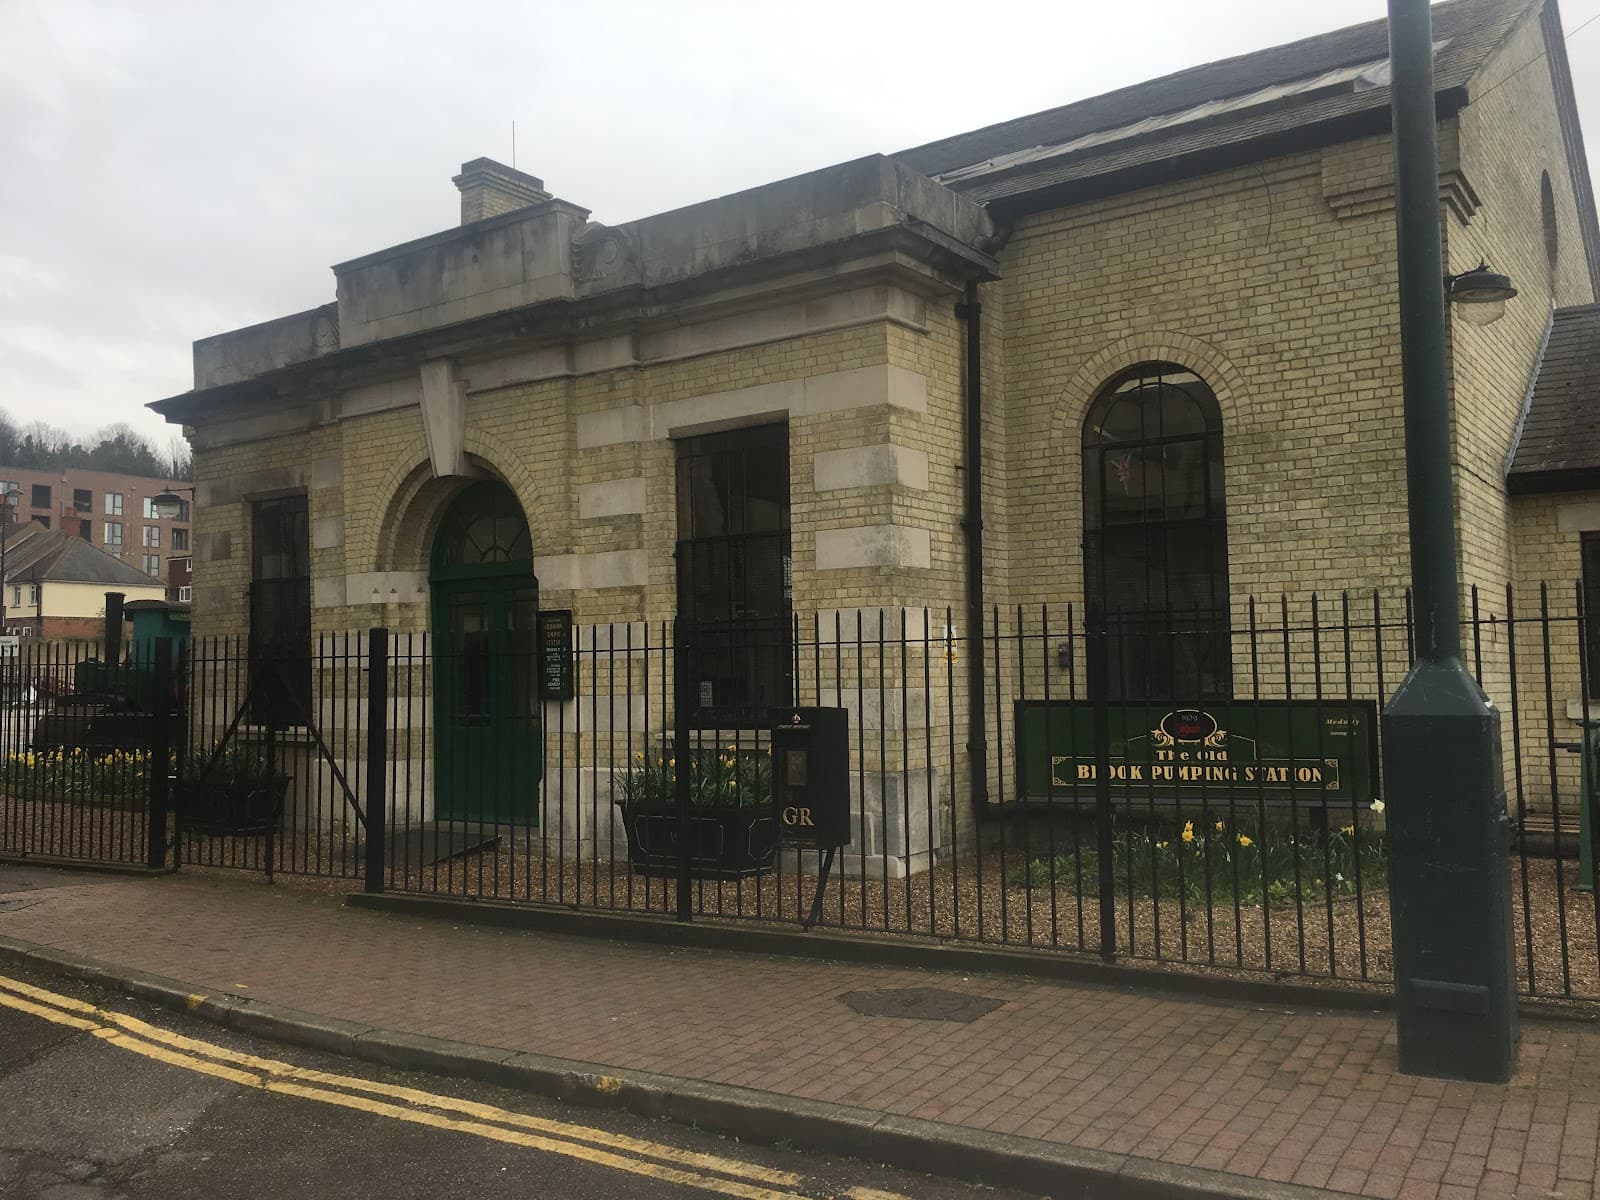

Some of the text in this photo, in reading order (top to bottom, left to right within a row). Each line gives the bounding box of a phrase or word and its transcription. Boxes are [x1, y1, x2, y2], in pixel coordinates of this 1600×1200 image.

[1156, 750, 1228, 761] The Old
[1151, 765, 1238, 781] PUMPING
[782, 806, 815, 826] GR
